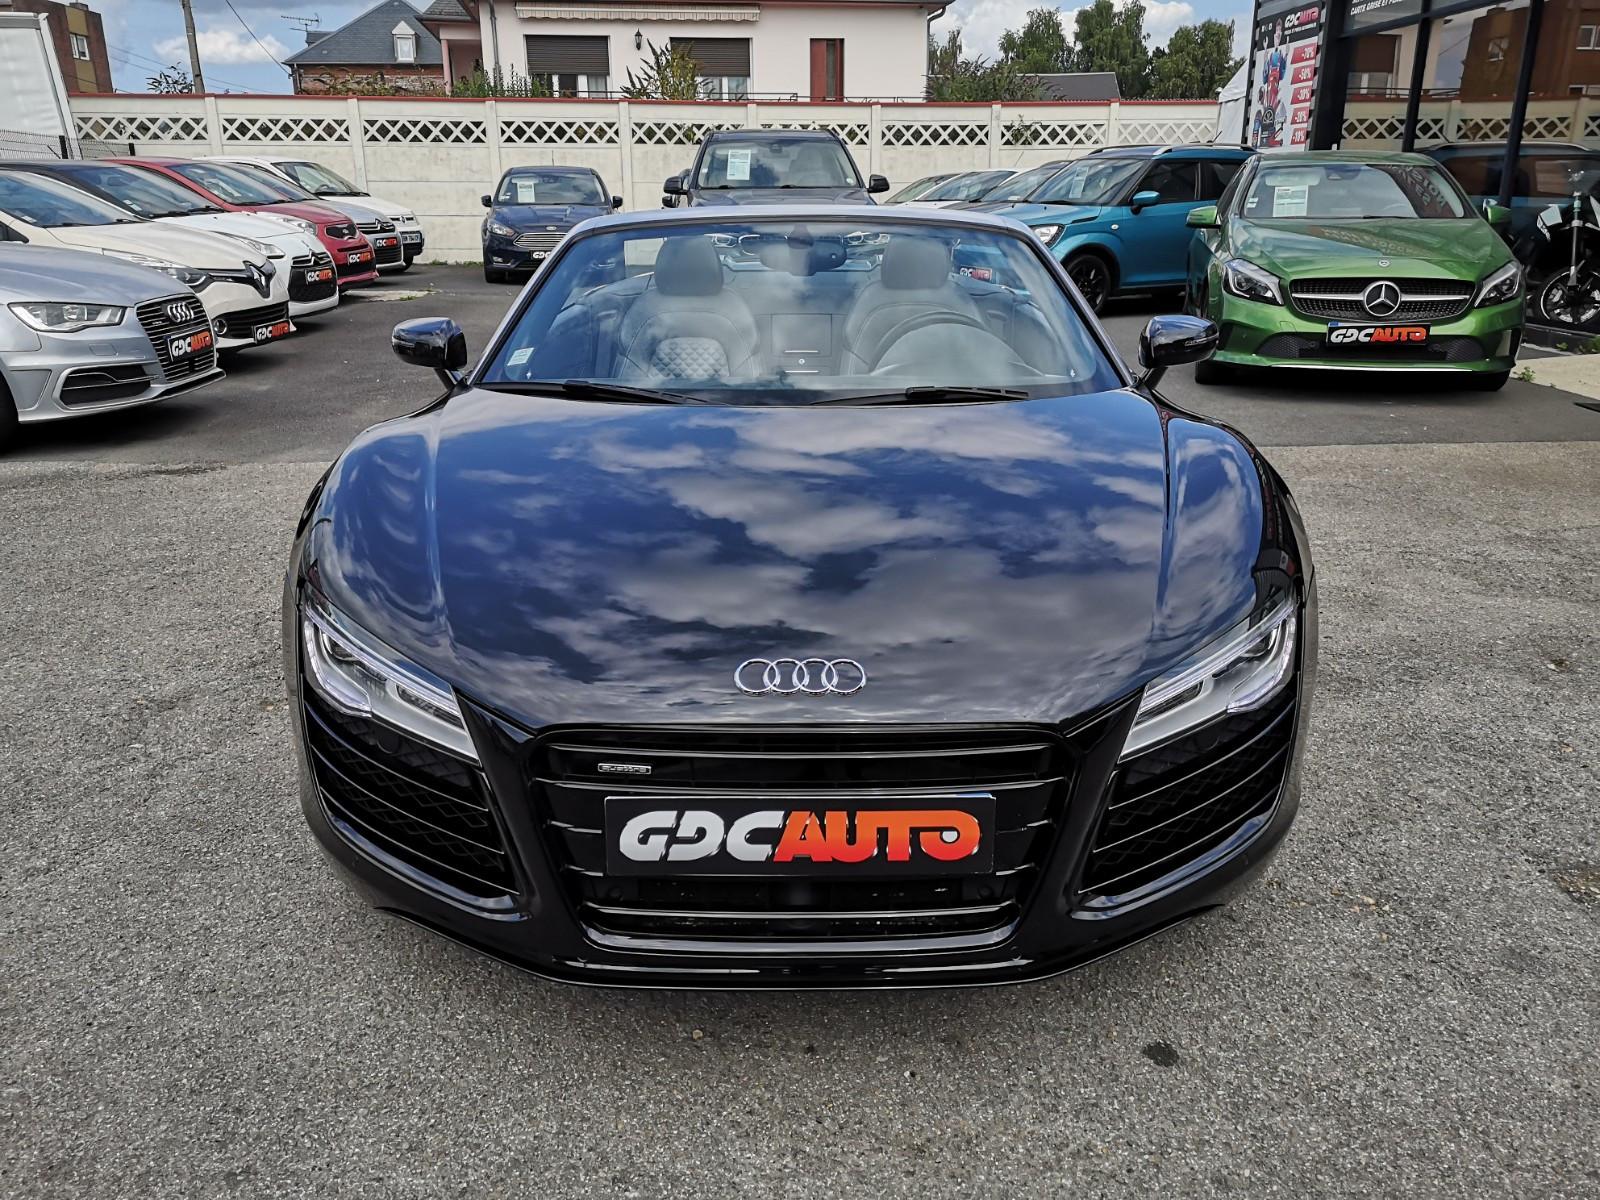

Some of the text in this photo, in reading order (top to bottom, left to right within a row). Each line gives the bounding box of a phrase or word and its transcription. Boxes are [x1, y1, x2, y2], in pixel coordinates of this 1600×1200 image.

[1350, 3, 1367, 16] CARTE
[1366, 0, 1382, 11] GRISE
[256, 321, 289, 340] GDCAUTO
[1330, 327, 1427, 343] GDCAUTO
[171, 331, 212, 357] GDCAUTO
[619, 810, 981, 863] GDCAUTO
